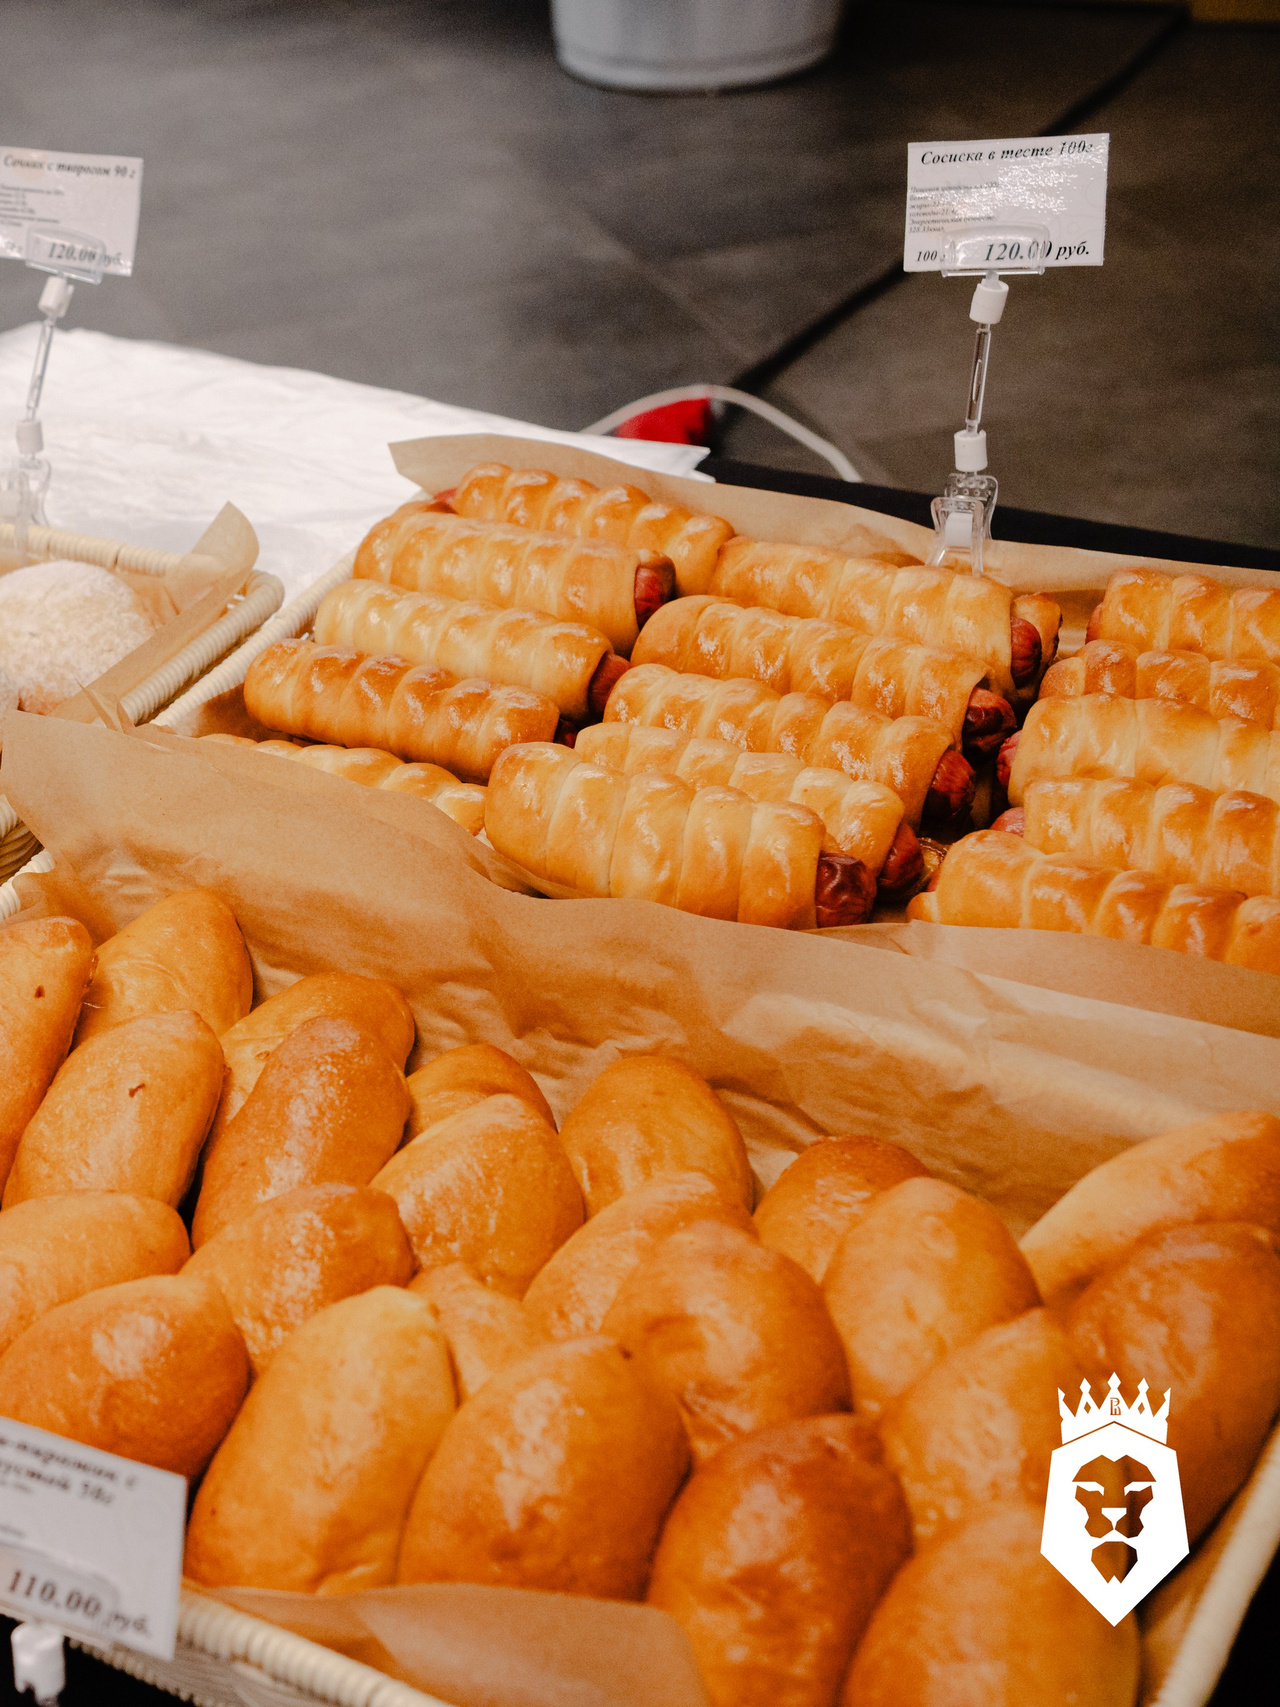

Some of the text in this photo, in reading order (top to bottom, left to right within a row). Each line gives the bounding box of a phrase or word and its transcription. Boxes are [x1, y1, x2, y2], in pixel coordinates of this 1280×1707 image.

[921, 140, 1093, 165] Сосиска в тесте 100г
[916, 250, 937, 262] 100
[984, 240, 1090, 262] 120.00 руб.
[7, 1569, 104, 1618] 110.00
